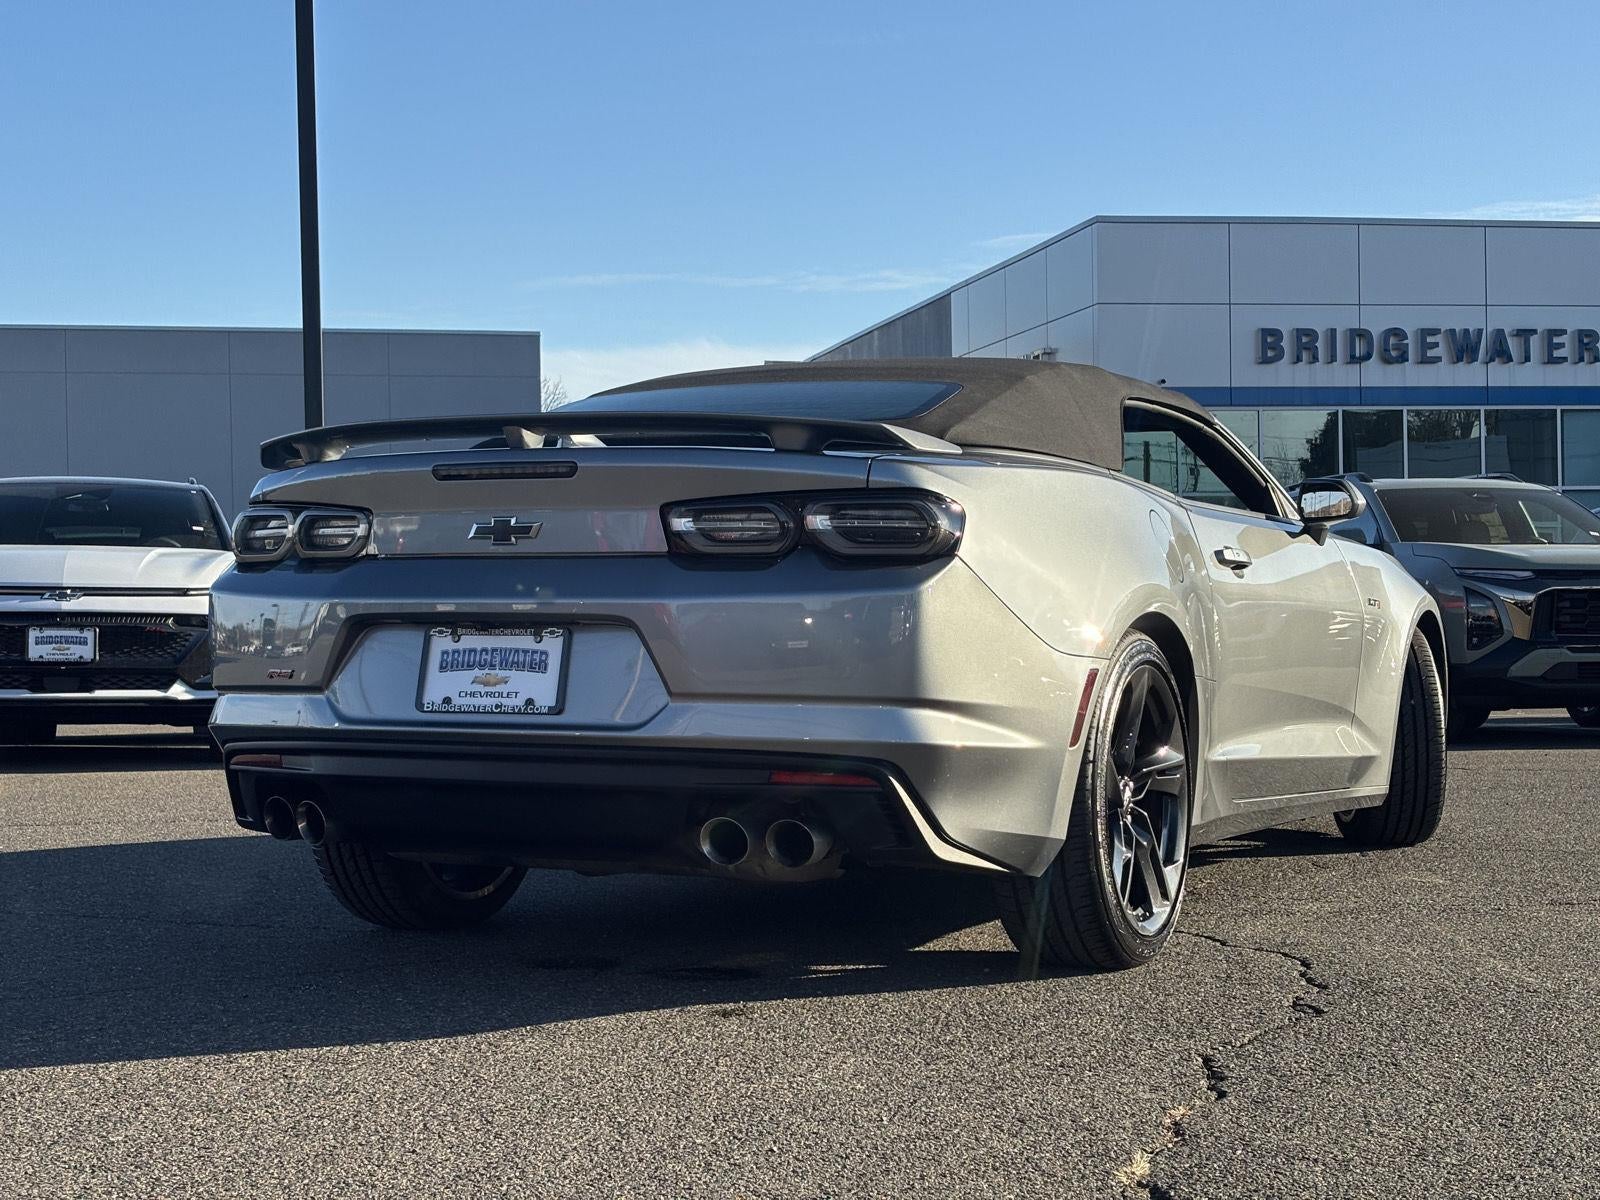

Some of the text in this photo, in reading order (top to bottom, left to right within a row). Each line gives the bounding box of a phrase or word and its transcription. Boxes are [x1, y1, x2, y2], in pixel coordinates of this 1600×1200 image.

[1256, 327, 1600, 364] BRIDGEWATER
[34, 635, 89, 646] BRIDGEWATER
[438, 646, 550, 673] BRIDGEWATER
[458, 690, 520, 699] CHEVROLET
